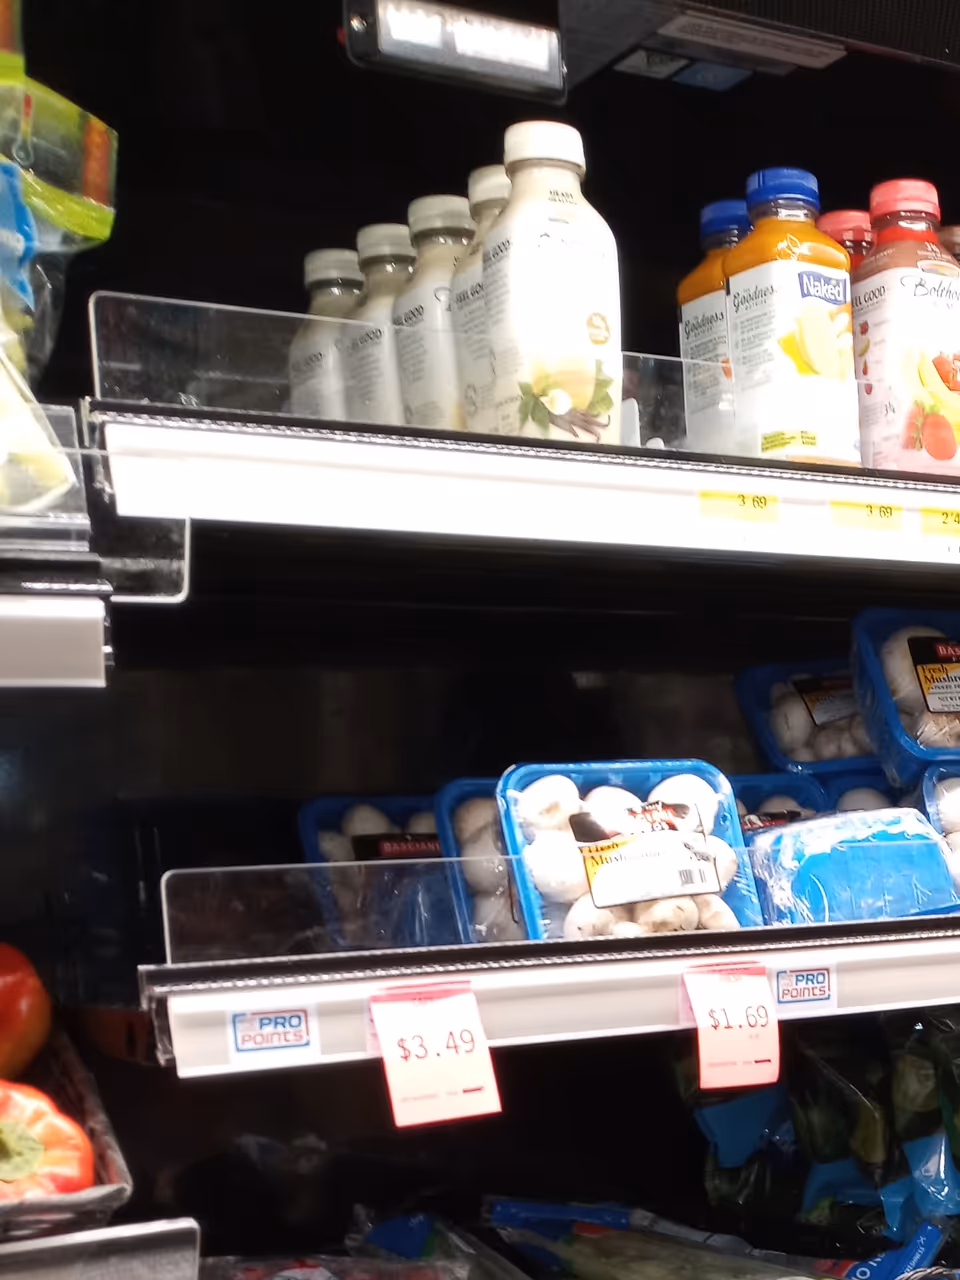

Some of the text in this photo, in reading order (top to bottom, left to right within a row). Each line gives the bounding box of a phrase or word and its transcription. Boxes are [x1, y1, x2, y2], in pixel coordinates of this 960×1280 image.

[803, 274, 842, 300] Naked
[921, 664, 949, 675] Fresh
[792, 971, 827, 988] PRO
[780, 984, 827, 1000] POINTS
[259, 1014, 302, 1031] PRO
[709, 1006, 769, 1031] $1.69
[240, 1029, 304, 1047] POINTS
[397, 1029, 476, 1062] $3.49
